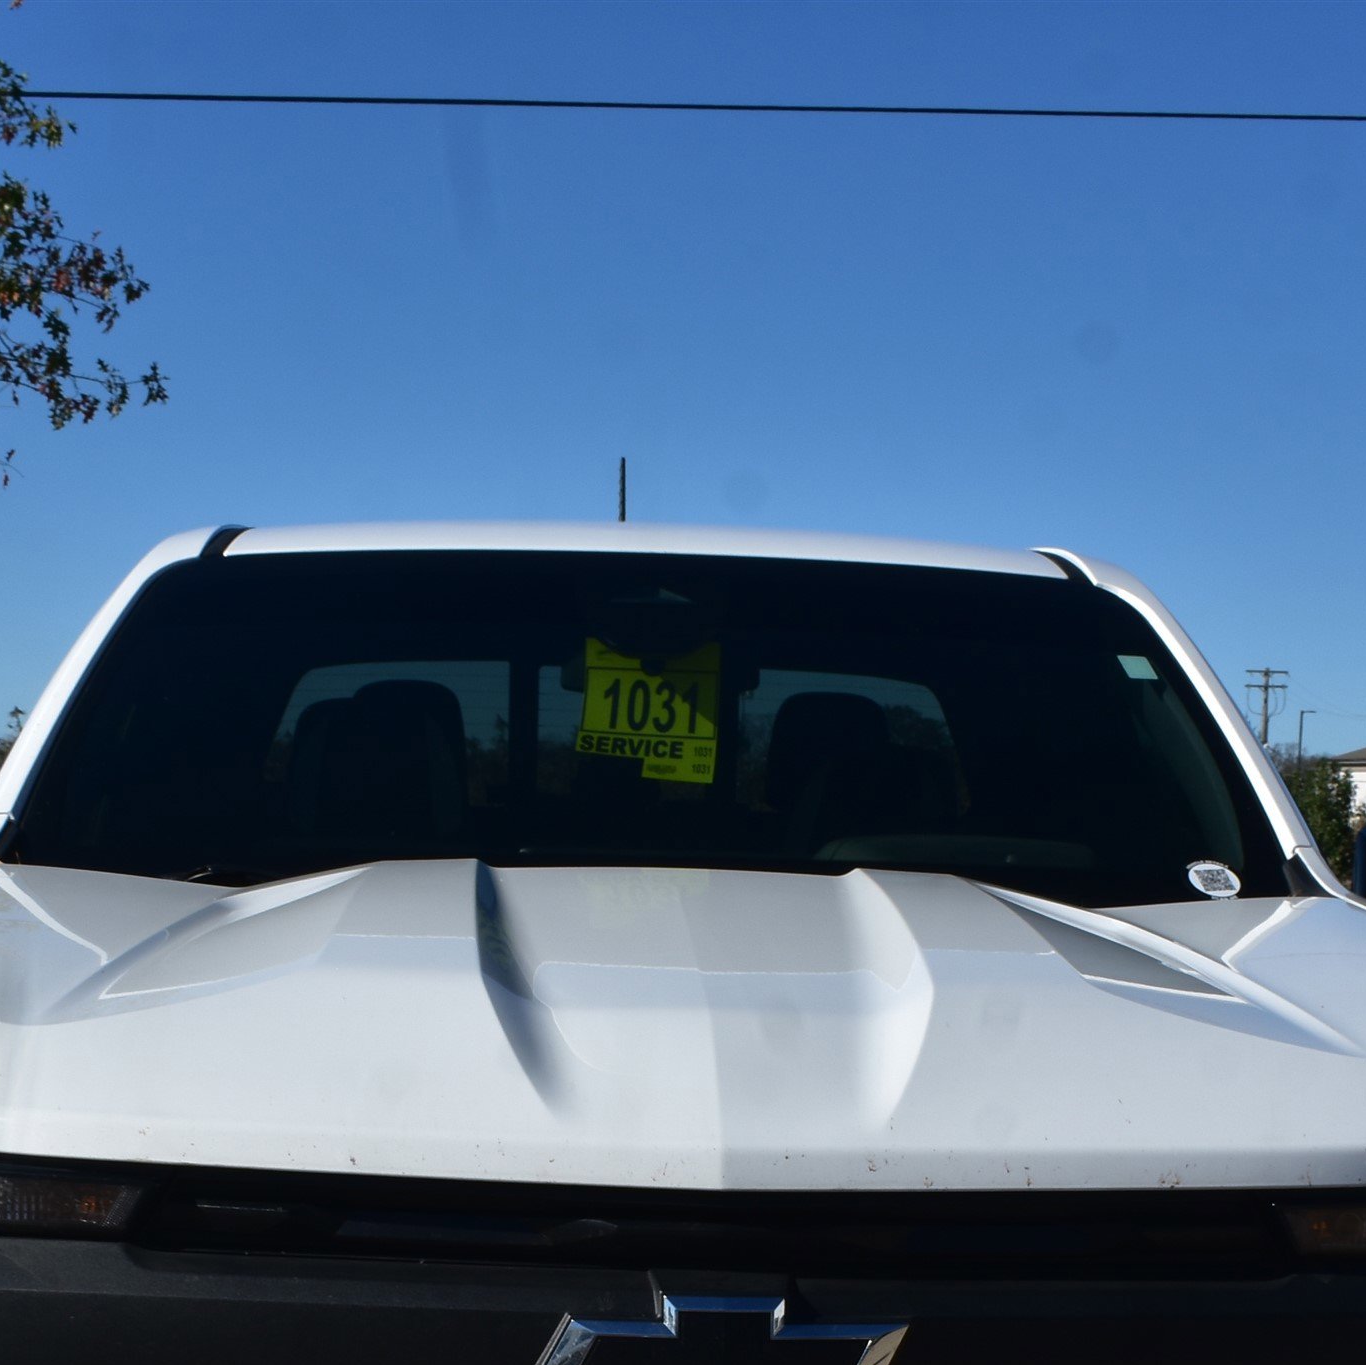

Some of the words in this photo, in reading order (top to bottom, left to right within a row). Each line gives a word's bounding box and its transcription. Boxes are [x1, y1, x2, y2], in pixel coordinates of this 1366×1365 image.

[603, 678, 699, 734] 1031
[579, 735, 684, 760] SERVICE
[694, 746, 713, 758] 1031
[691, 763, 711, 775] 1031
